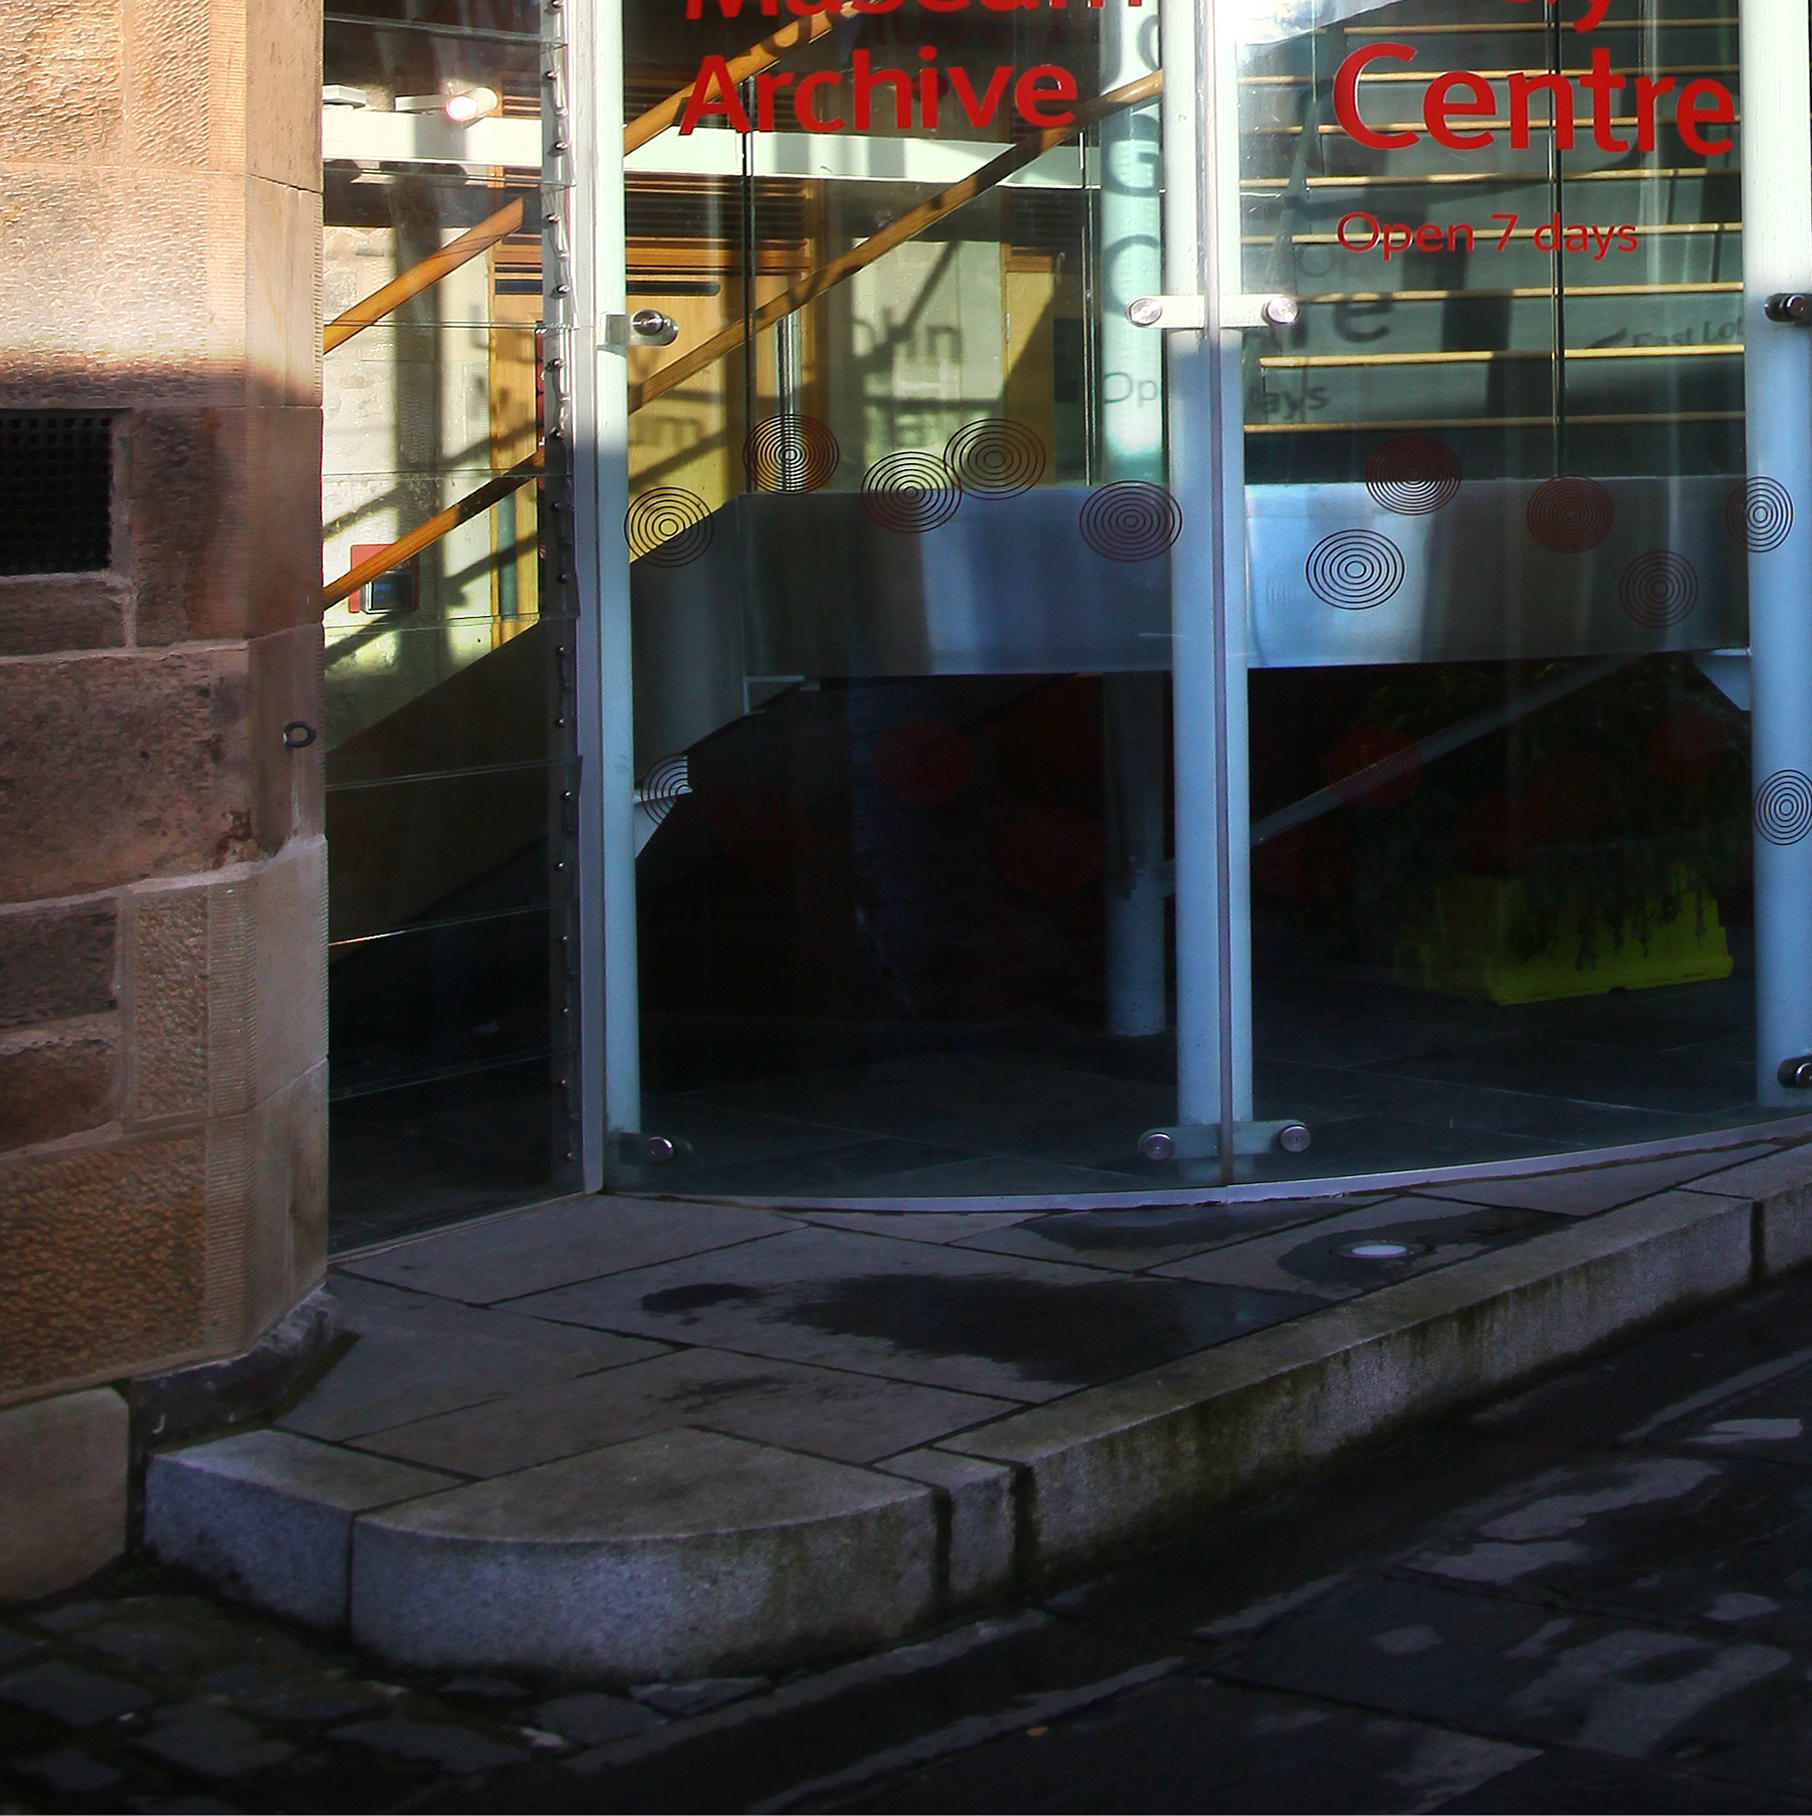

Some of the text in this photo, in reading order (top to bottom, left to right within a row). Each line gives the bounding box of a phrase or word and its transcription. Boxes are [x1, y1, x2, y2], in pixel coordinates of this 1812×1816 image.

[679, 44, 1079, 137] Archive
[1333, 42, 1736, 156] Centre
[1337, 211, 1639, 261] Open 7 days
